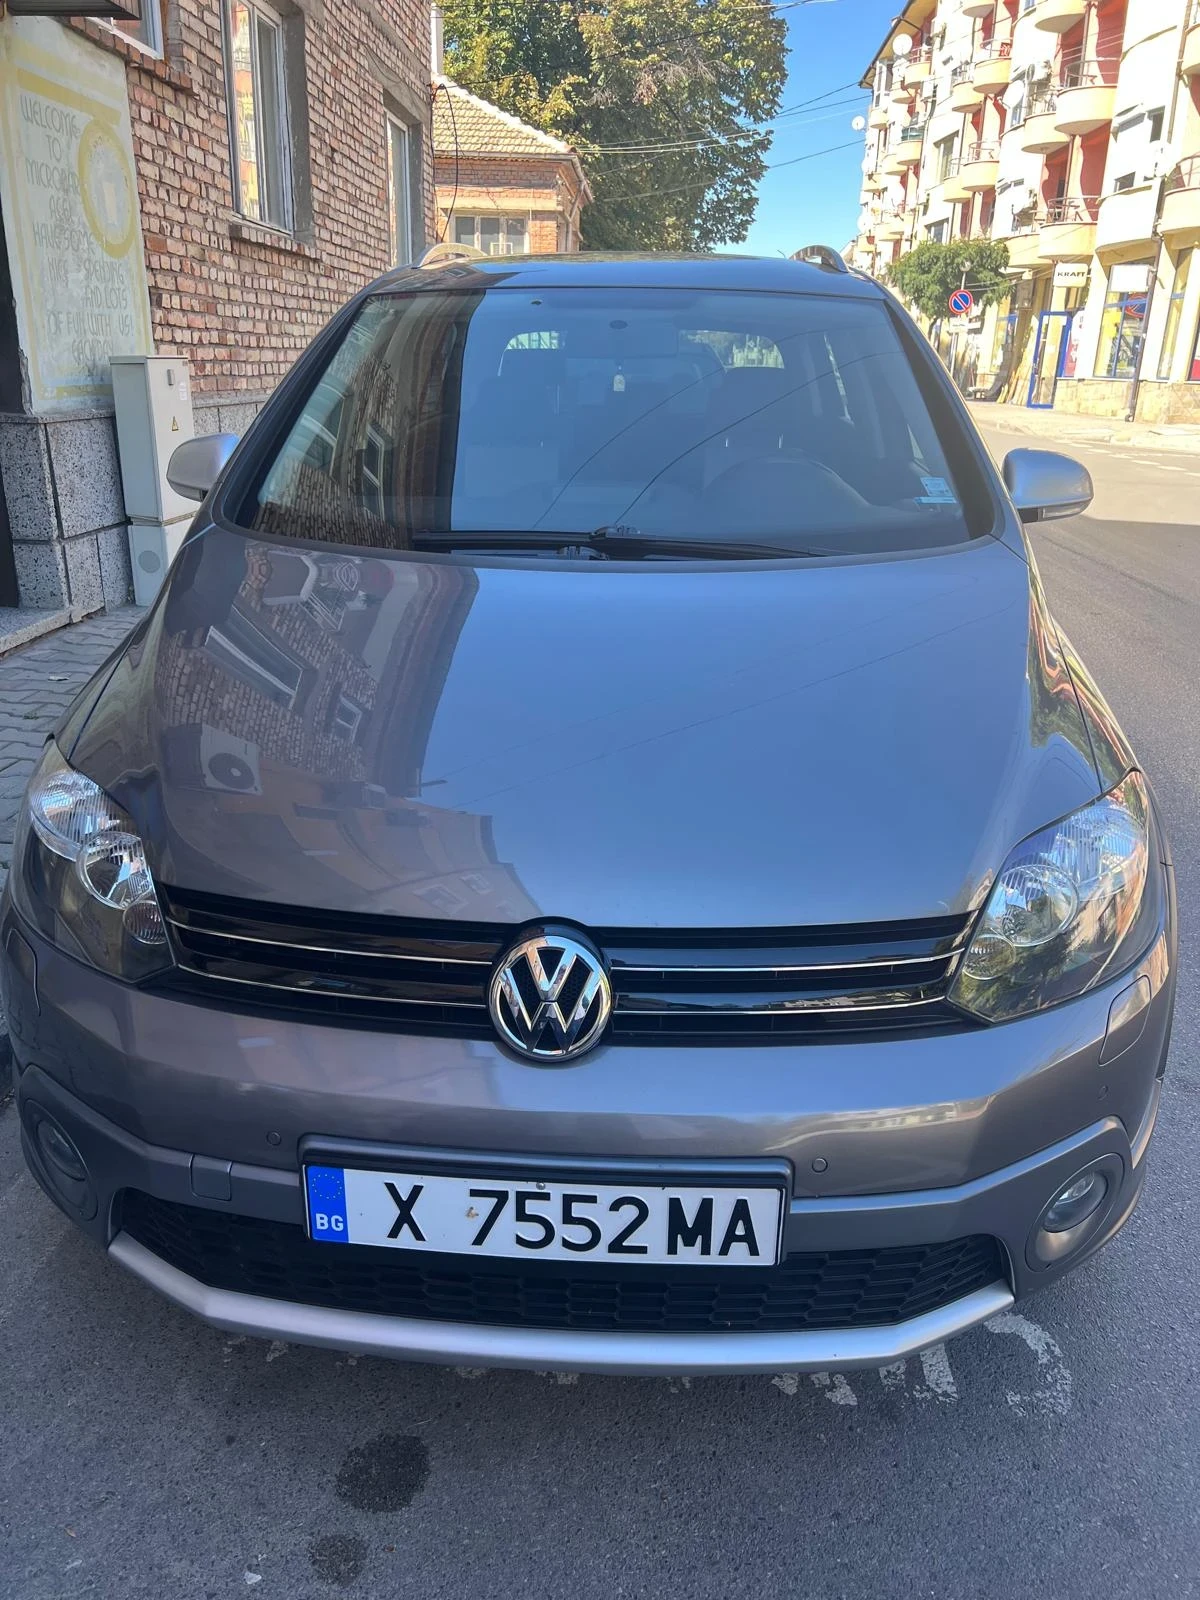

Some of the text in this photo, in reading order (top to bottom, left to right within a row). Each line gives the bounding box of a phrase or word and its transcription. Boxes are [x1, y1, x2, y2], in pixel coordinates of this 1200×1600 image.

[20, 94, 80, 140] WELCOME
[46, 134, 62, 162] TO
[104, 287, 128, 310] LOTS
[48, 310, 64, 336] OF
[87, 312, 111, 336] WITH
[315, 1213, 345, 1232] BG
[384, 1181, 760, 1257] X 7552 MA
